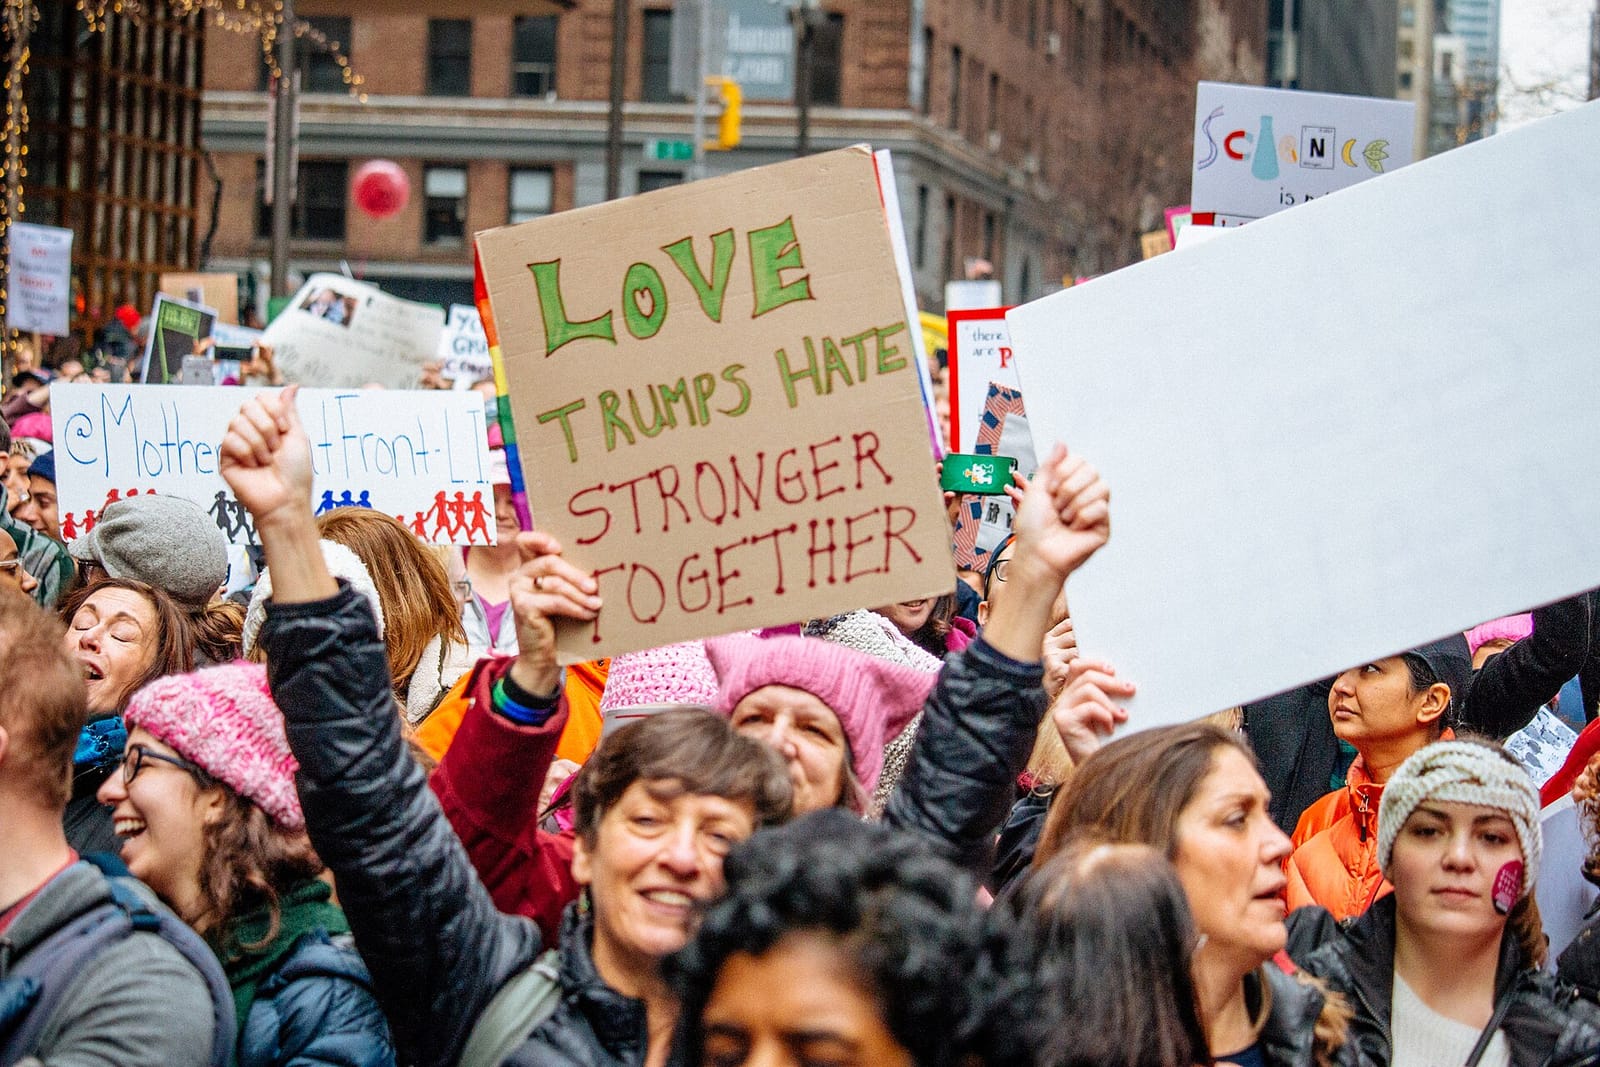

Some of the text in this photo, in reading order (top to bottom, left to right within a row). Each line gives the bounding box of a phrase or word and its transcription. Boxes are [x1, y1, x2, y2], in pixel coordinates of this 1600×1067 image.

[527, 215, 816, 358] LOVE
[536, 322, 907, 463] TRUMPS HATE
[568, 430, 894, 545] STRONGER
[591, 505, 923, 644] TOGETHER
